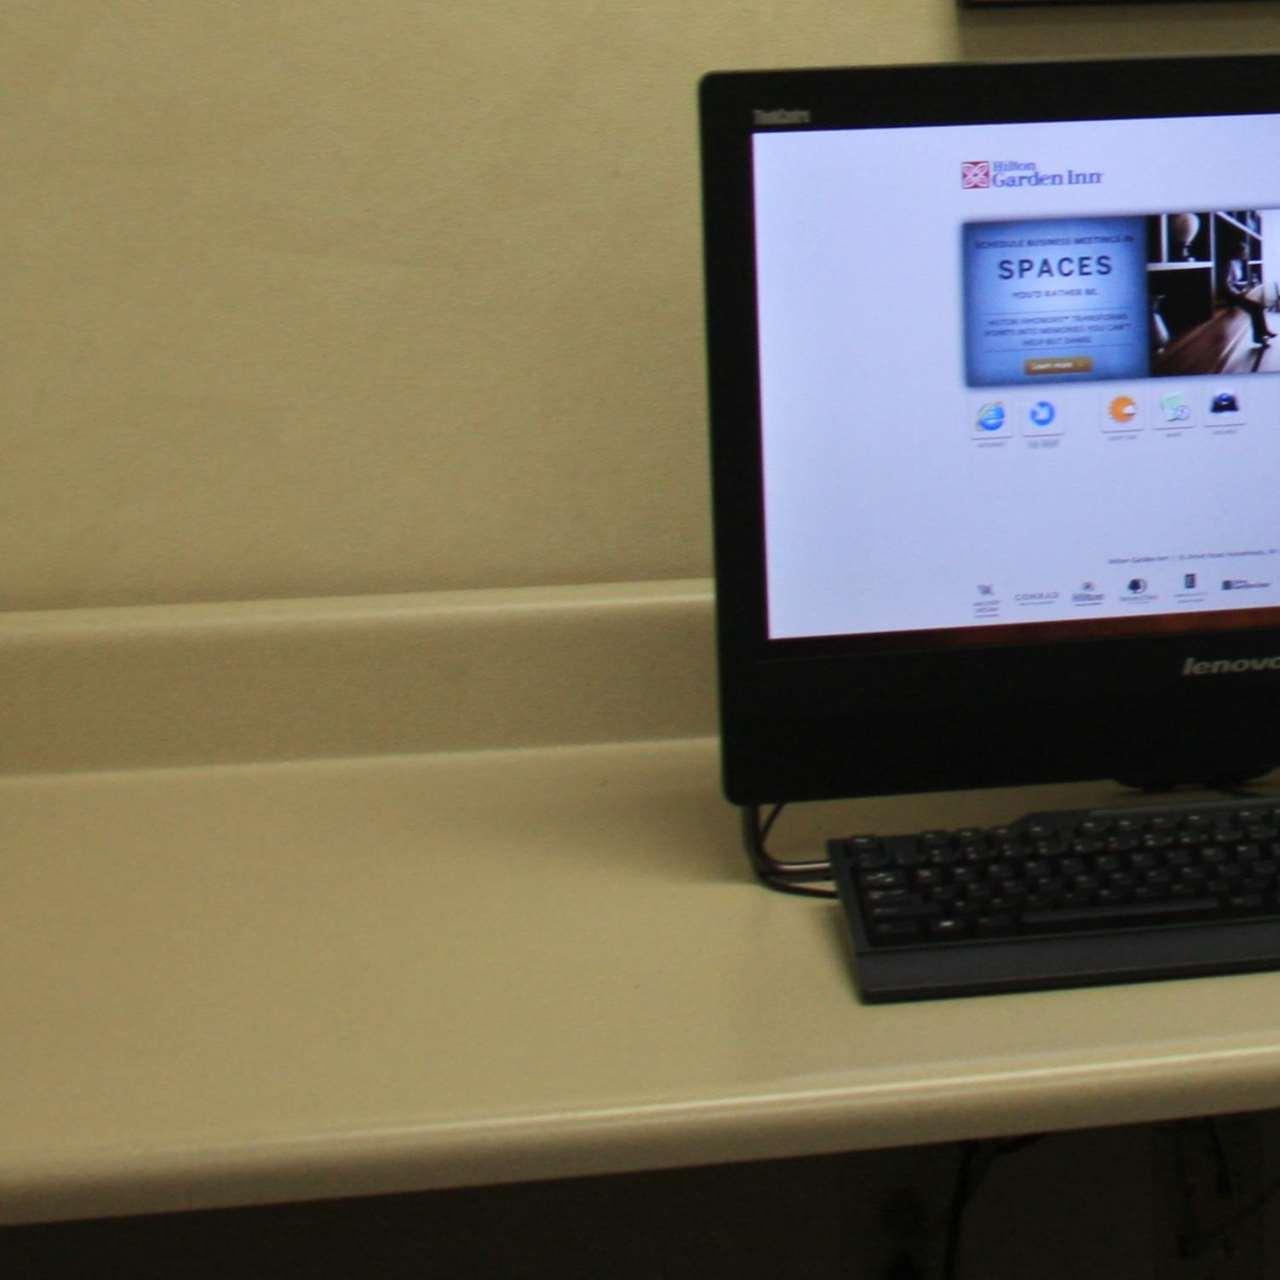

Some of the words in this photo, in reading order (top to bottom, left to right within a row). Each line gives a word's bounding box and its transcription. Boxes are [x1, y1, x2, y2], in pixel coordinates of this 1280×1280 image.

[993, 160, 1037, 171] Hilton
[992, 171, 1064, 188] Garden
[1067, 170, 1102, 185] Inn
[998, 255, 1113, 280] SPACES
